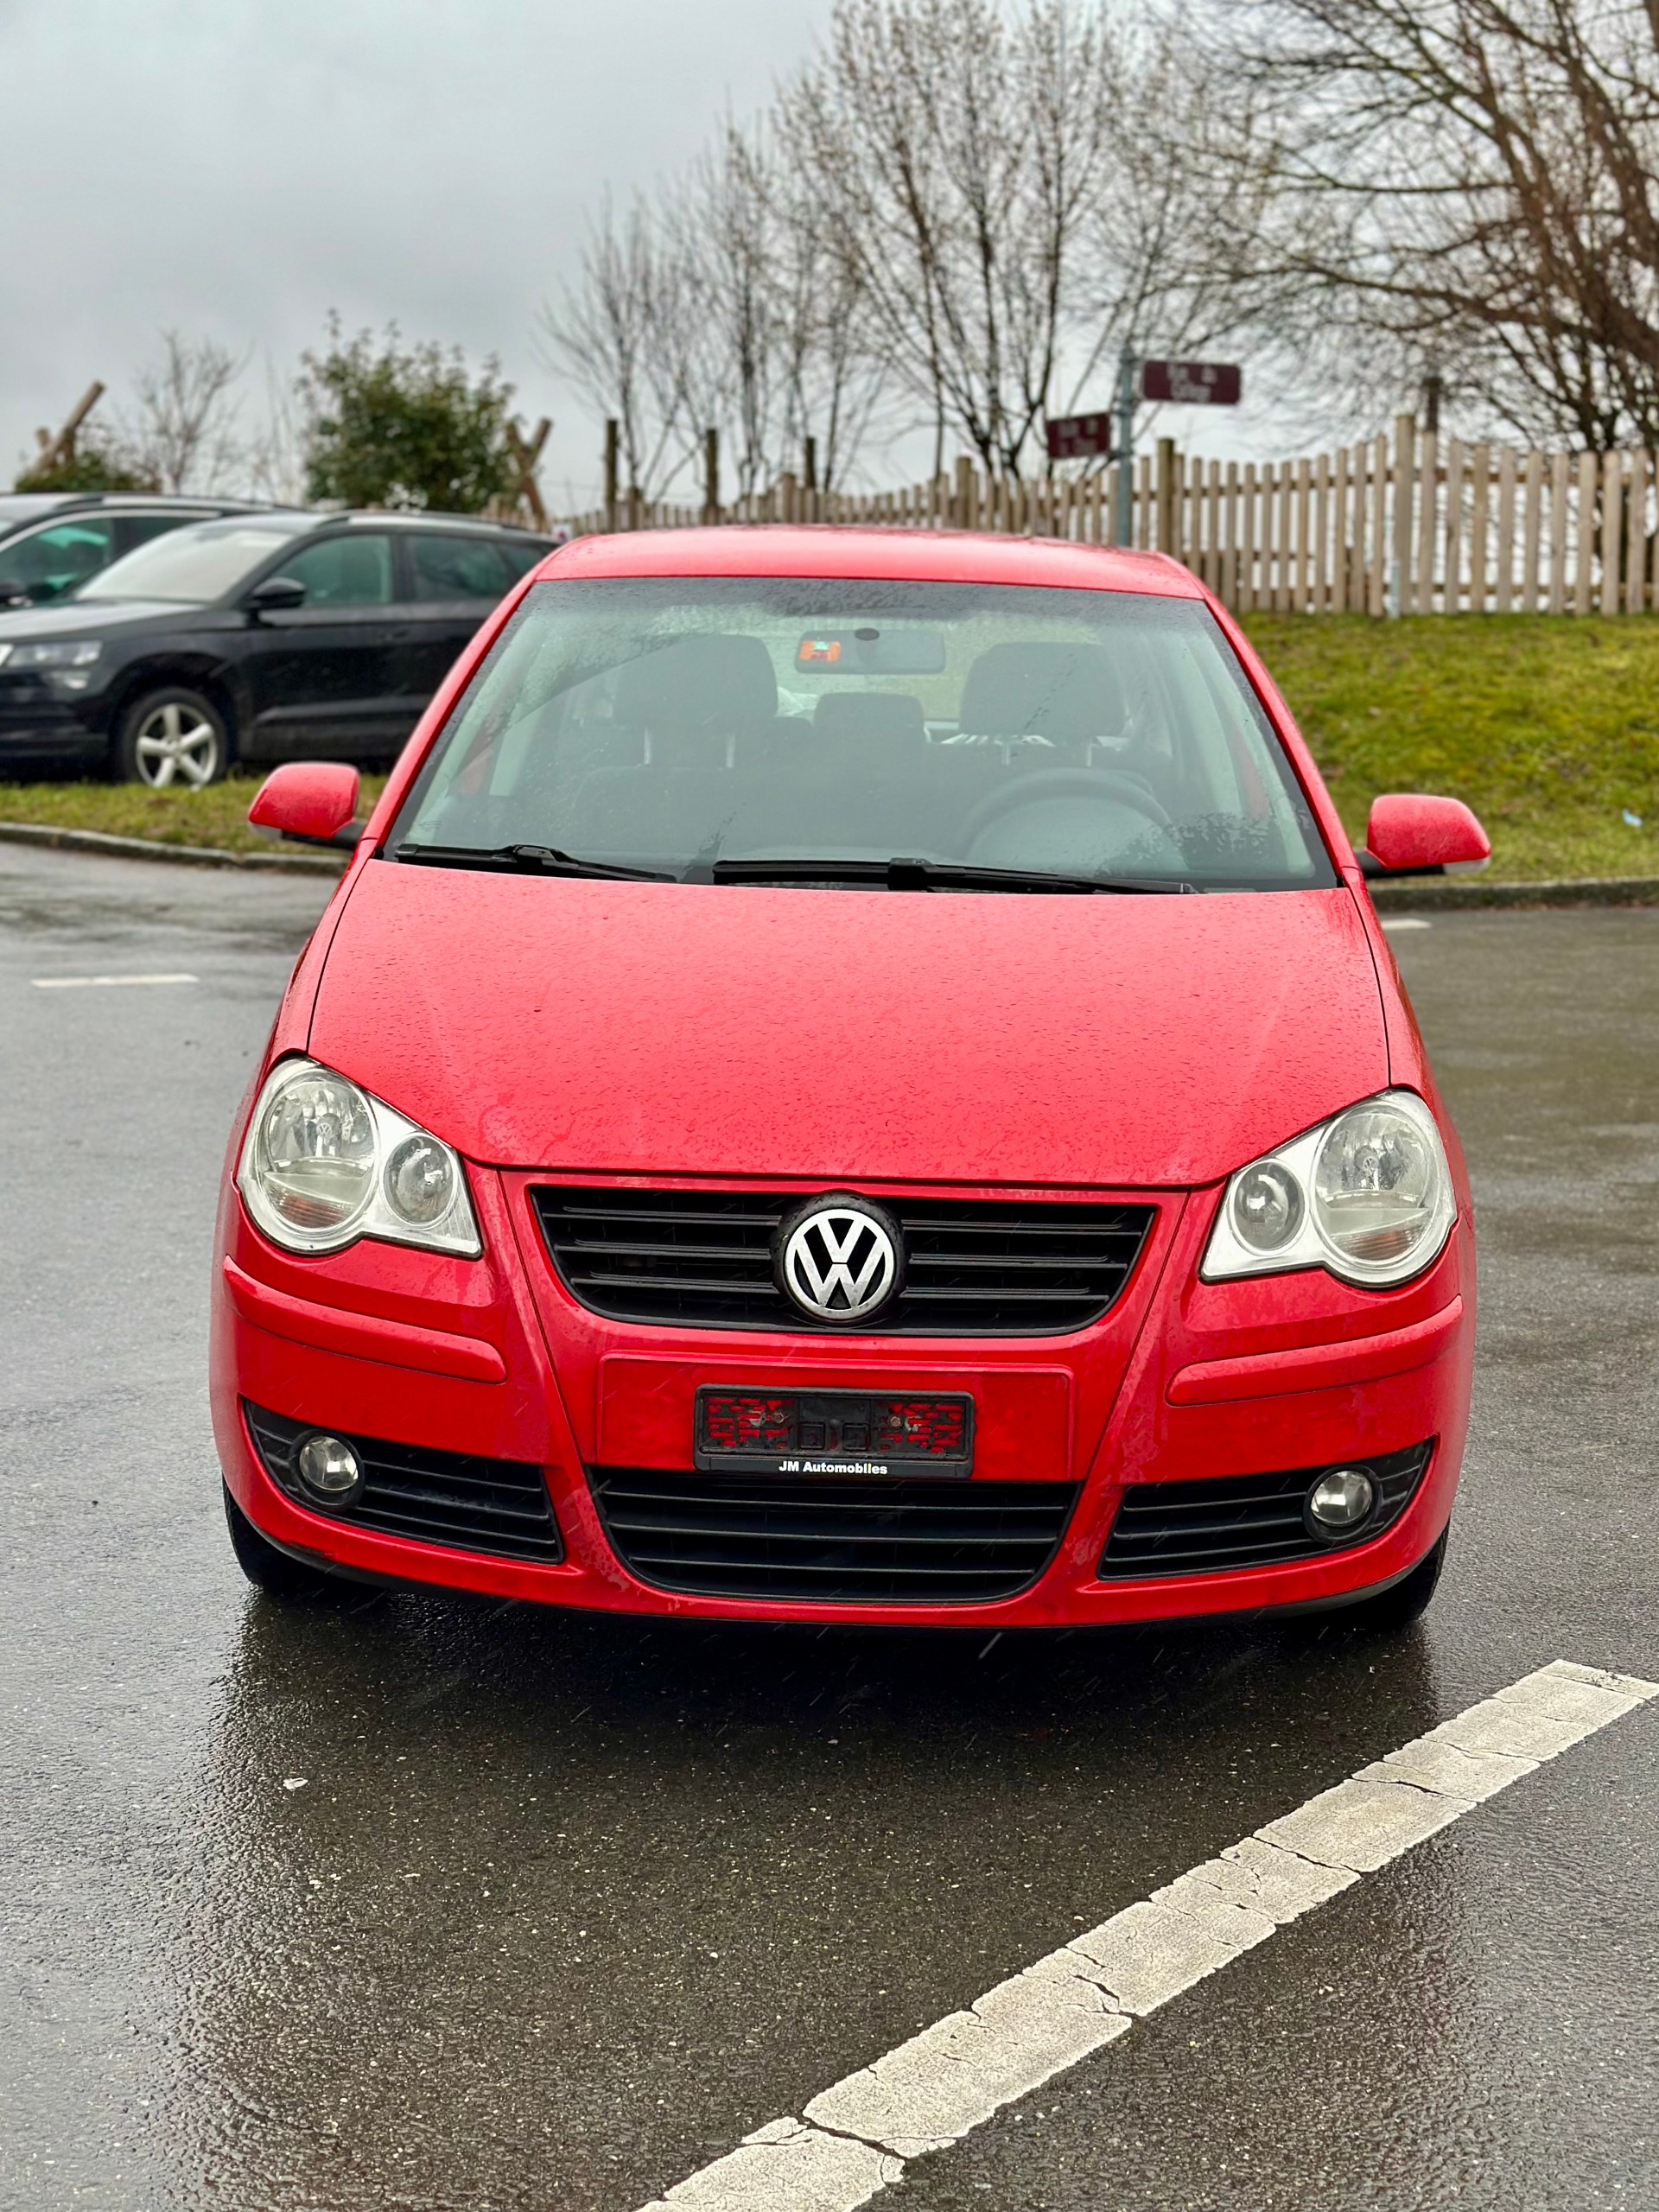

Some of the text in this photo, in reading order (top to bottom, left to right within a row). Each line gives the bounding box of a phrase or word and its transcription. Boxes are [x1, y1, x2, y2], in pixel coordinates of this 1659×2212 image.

[785, 1209, 894, 1319] VW
[779, 1460, 888, 1474] JM Automobiles
